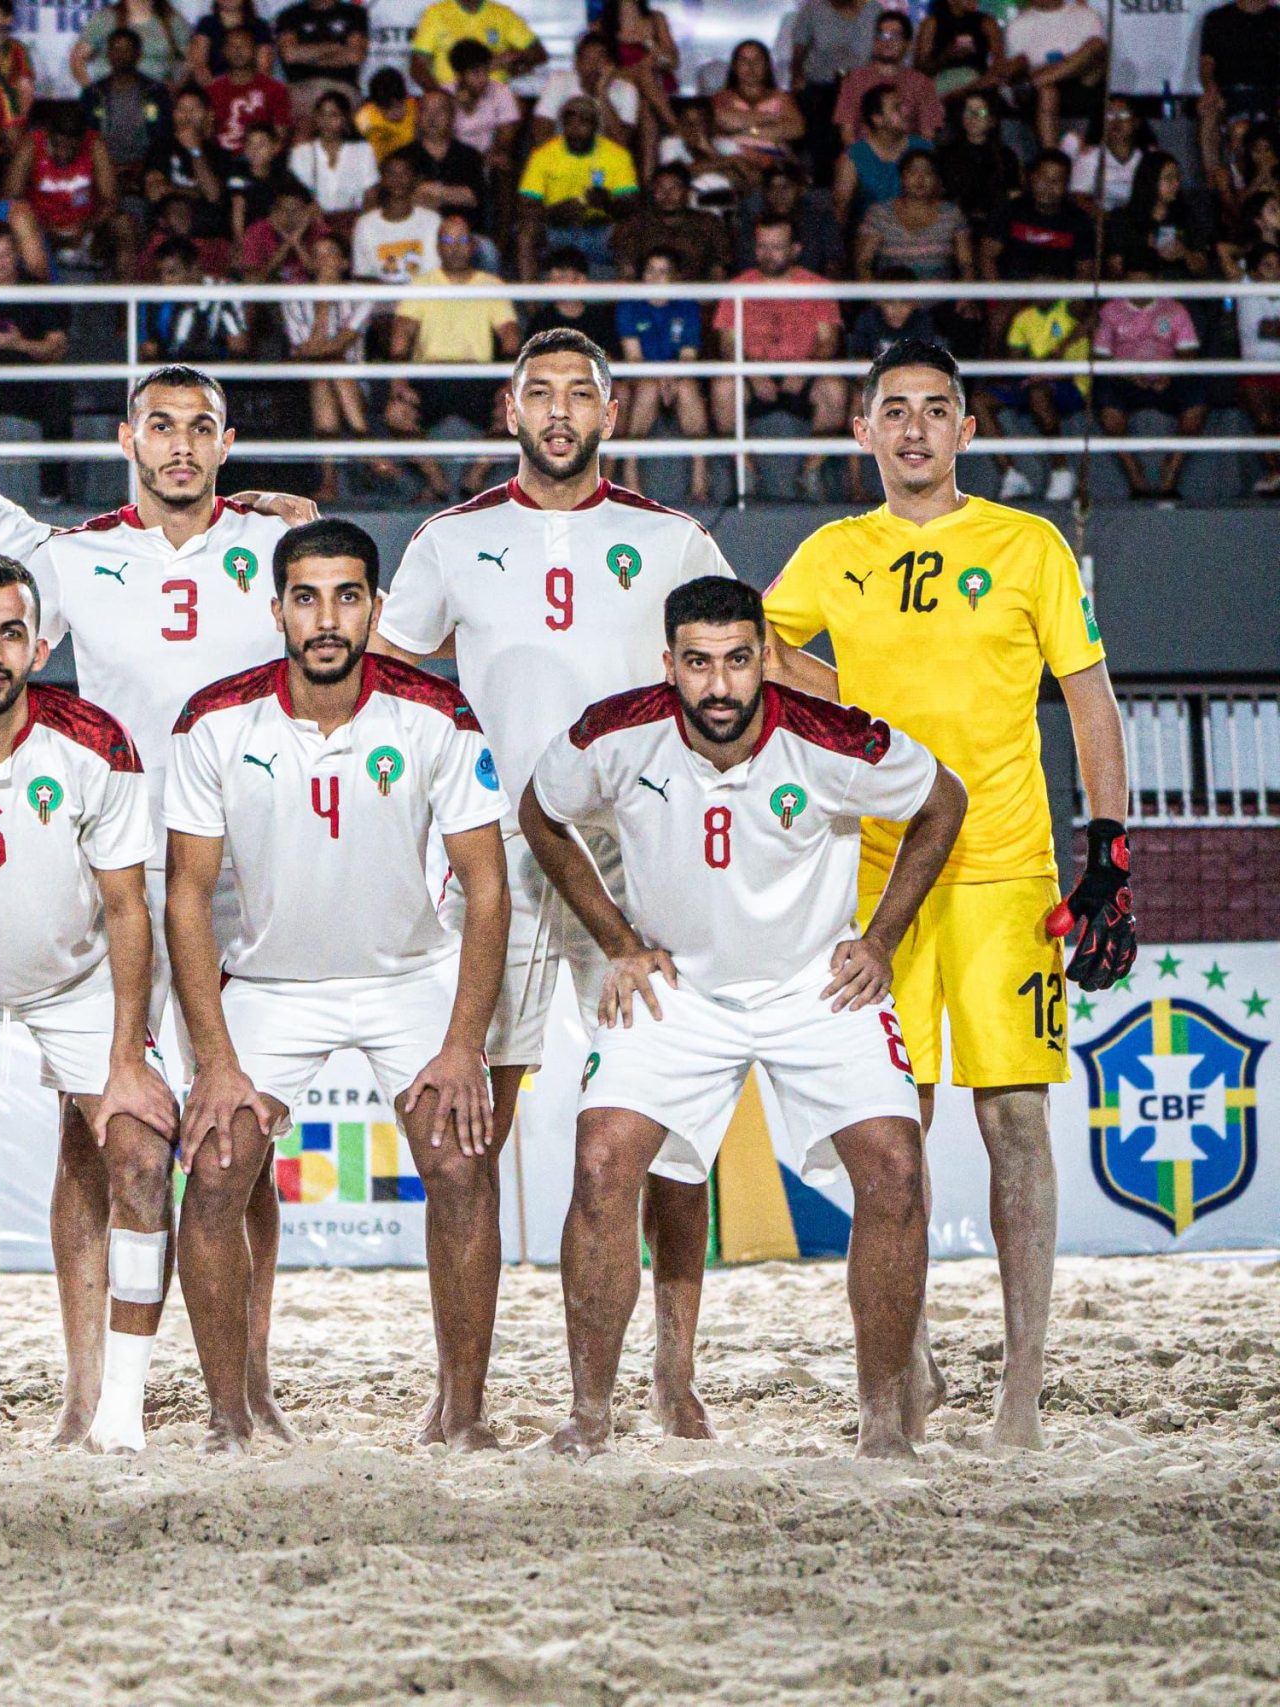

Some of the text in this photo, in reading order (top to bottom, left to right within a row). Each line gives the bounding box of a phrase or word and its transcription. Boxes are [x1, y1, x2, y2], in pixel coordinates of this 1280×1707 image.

[161, 578, 199, 642] 3
[544, 566, 574, 632] 9
[889, 550, 944, 613] 12
[310, 775, 340, 840] 4
[703, 805, 733, 870] 8
[1017, 971, 1063, 1039] 12
[296, 1088, 392, 1106] DERA
[1138, 1093, 1207, 1122] CBF
[281, 1214, 402, 1236] NSTRUÇÃO
